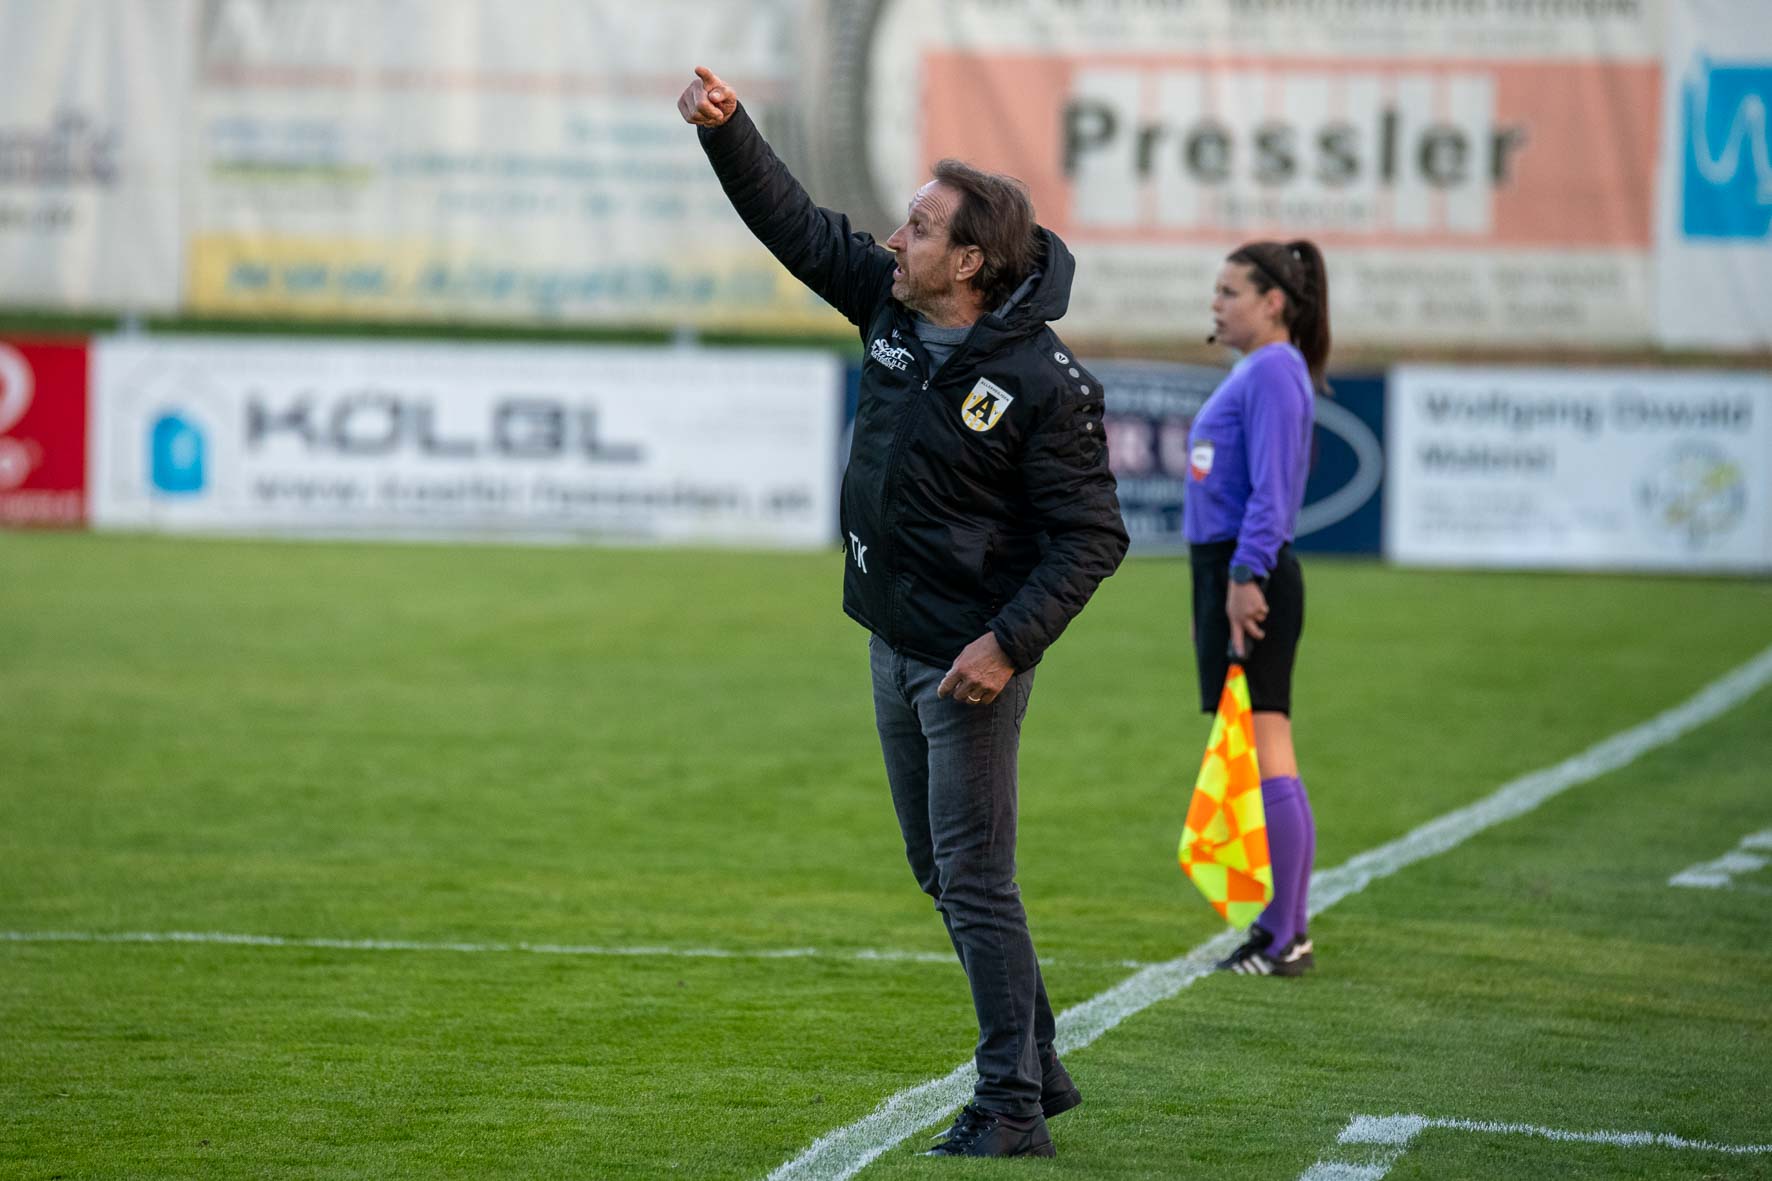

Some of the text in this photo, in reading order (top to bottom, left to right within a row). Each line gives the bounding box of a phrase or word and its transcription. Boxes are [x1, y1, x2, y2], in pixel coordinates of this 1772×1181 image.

[1062, 101, 1525, 188] Pressler
[967, 390, 1000, 426] A
[849, 531, 868, 574] TK
